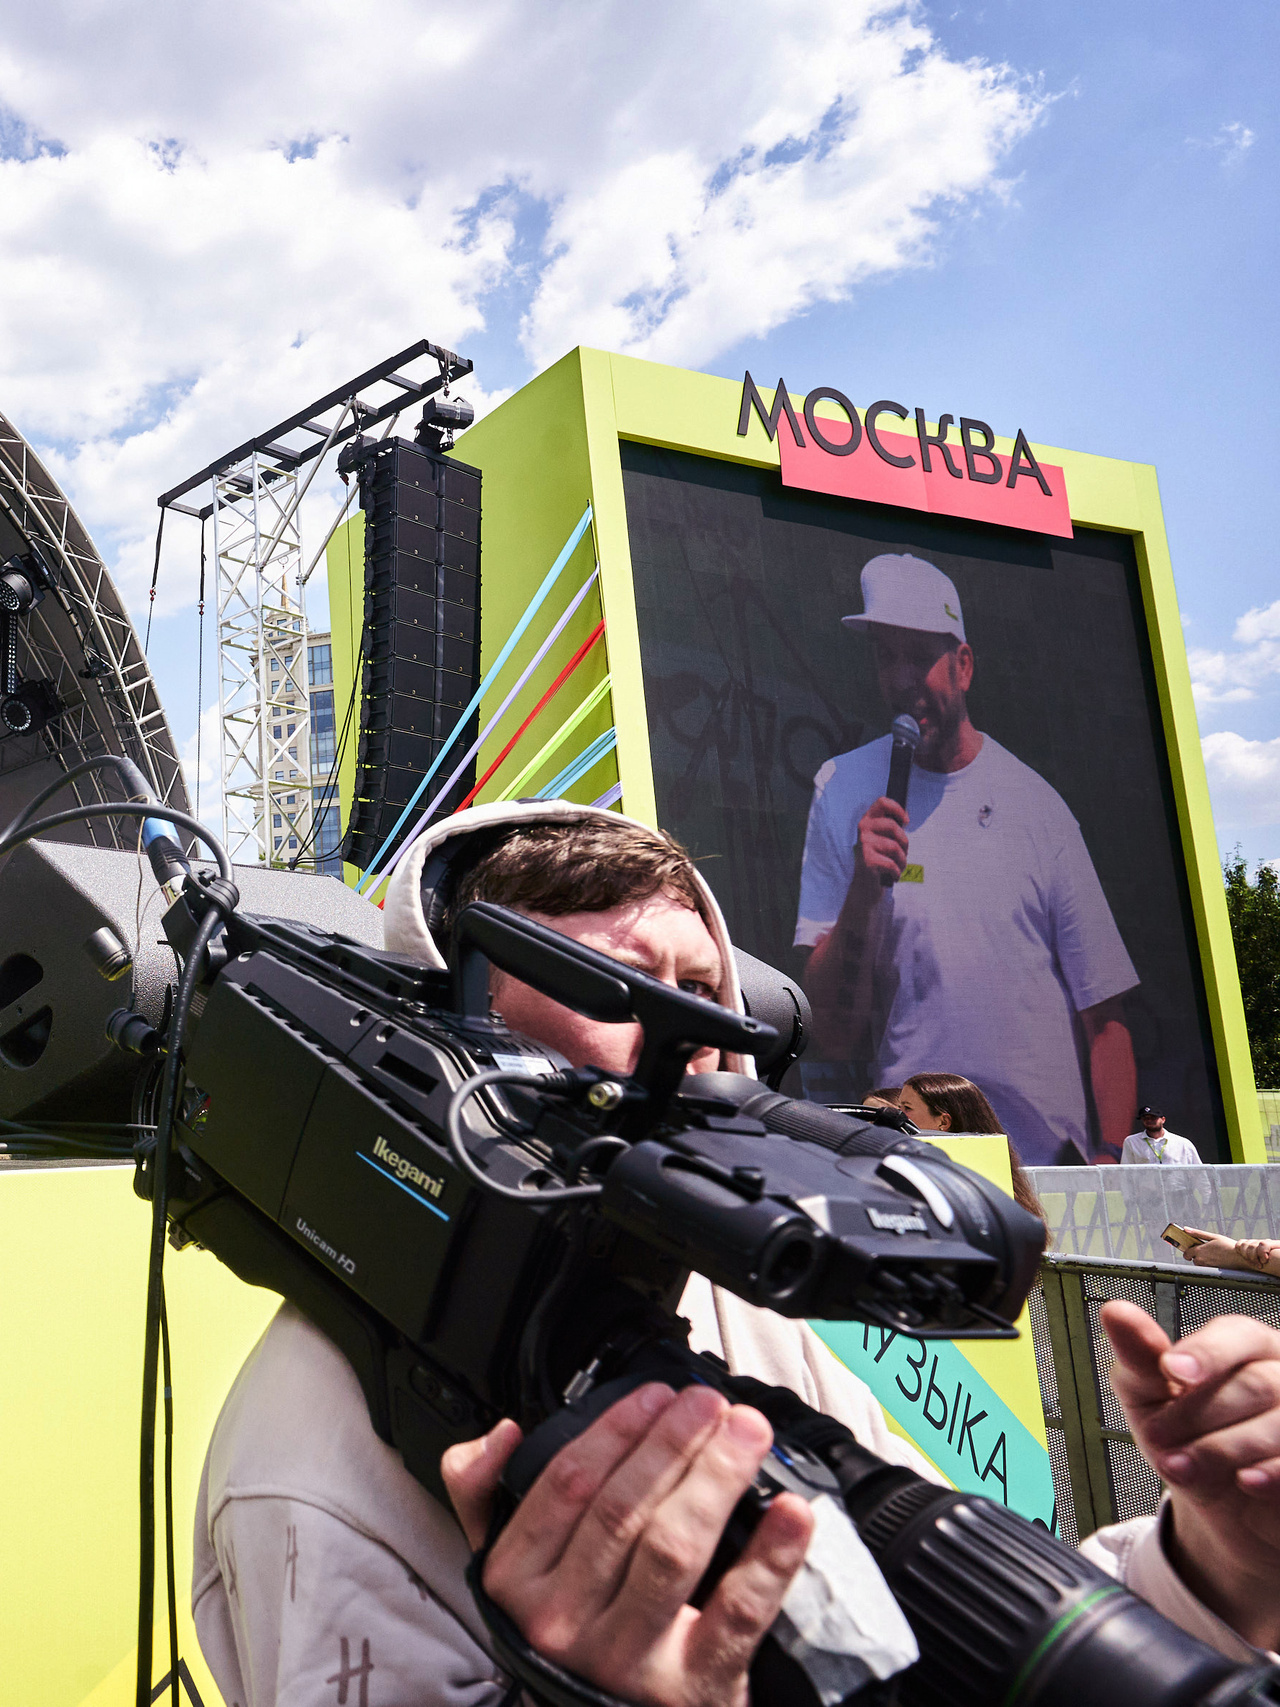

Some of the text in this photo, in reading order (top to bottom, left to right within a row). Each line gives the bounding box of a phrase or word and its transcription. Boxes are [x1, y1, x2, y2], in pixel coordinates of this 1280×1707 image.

[737, 370, 1053, 497] МОСКВА
[372, 1134, 446, 1199] Ikegami
[296, 1216, 357, 1275] Unicam HD
